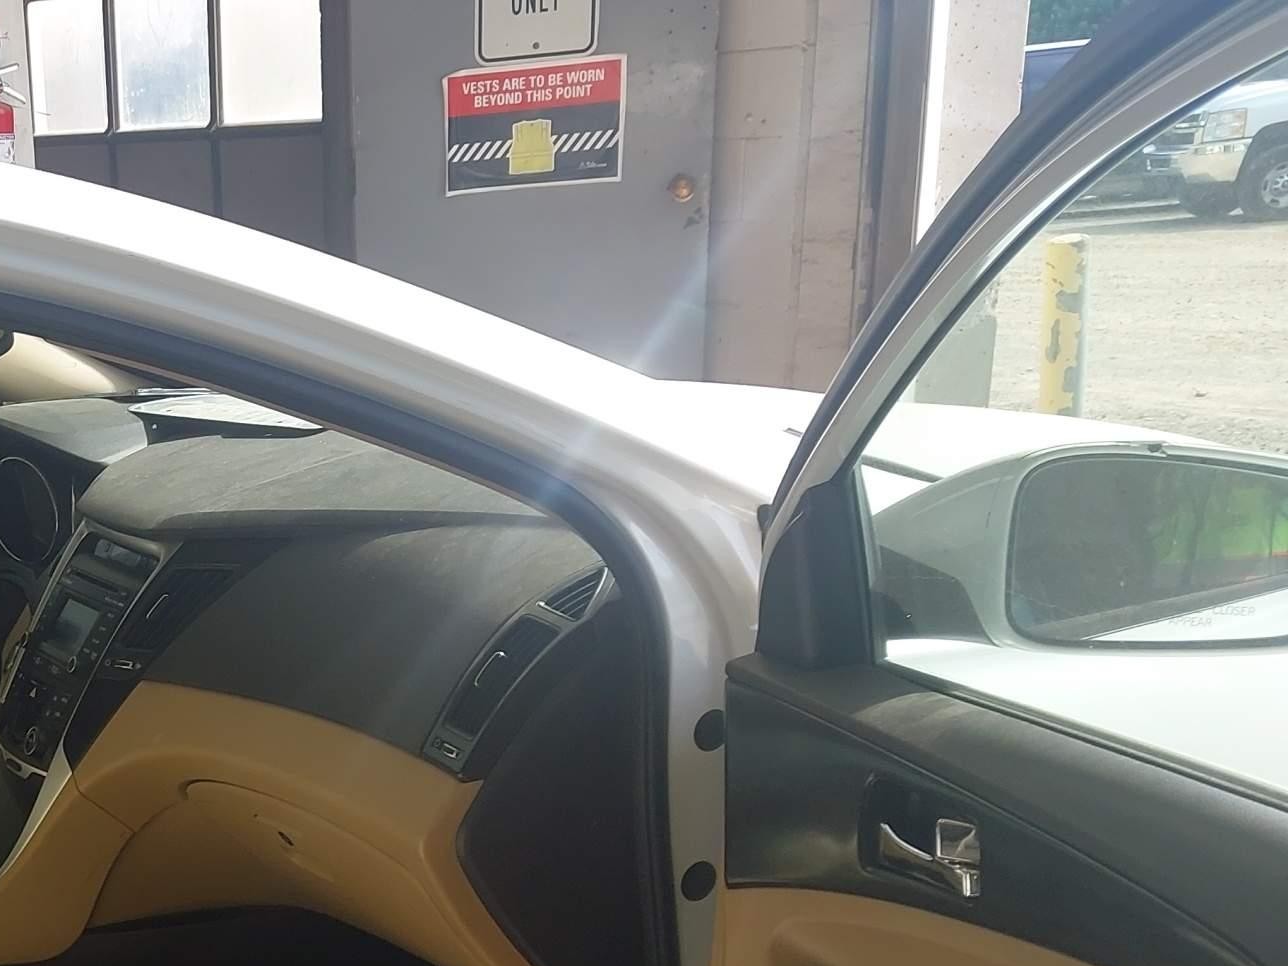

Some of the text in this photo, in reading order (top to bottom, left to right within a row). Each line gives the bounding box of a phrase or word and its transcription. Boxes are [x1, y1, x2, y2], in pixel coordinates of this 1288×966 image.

[462, 68, 605, 95] VESTS ARE TO BE WORN
[474, 84, 592, 108] BEYOND THIS POINT
